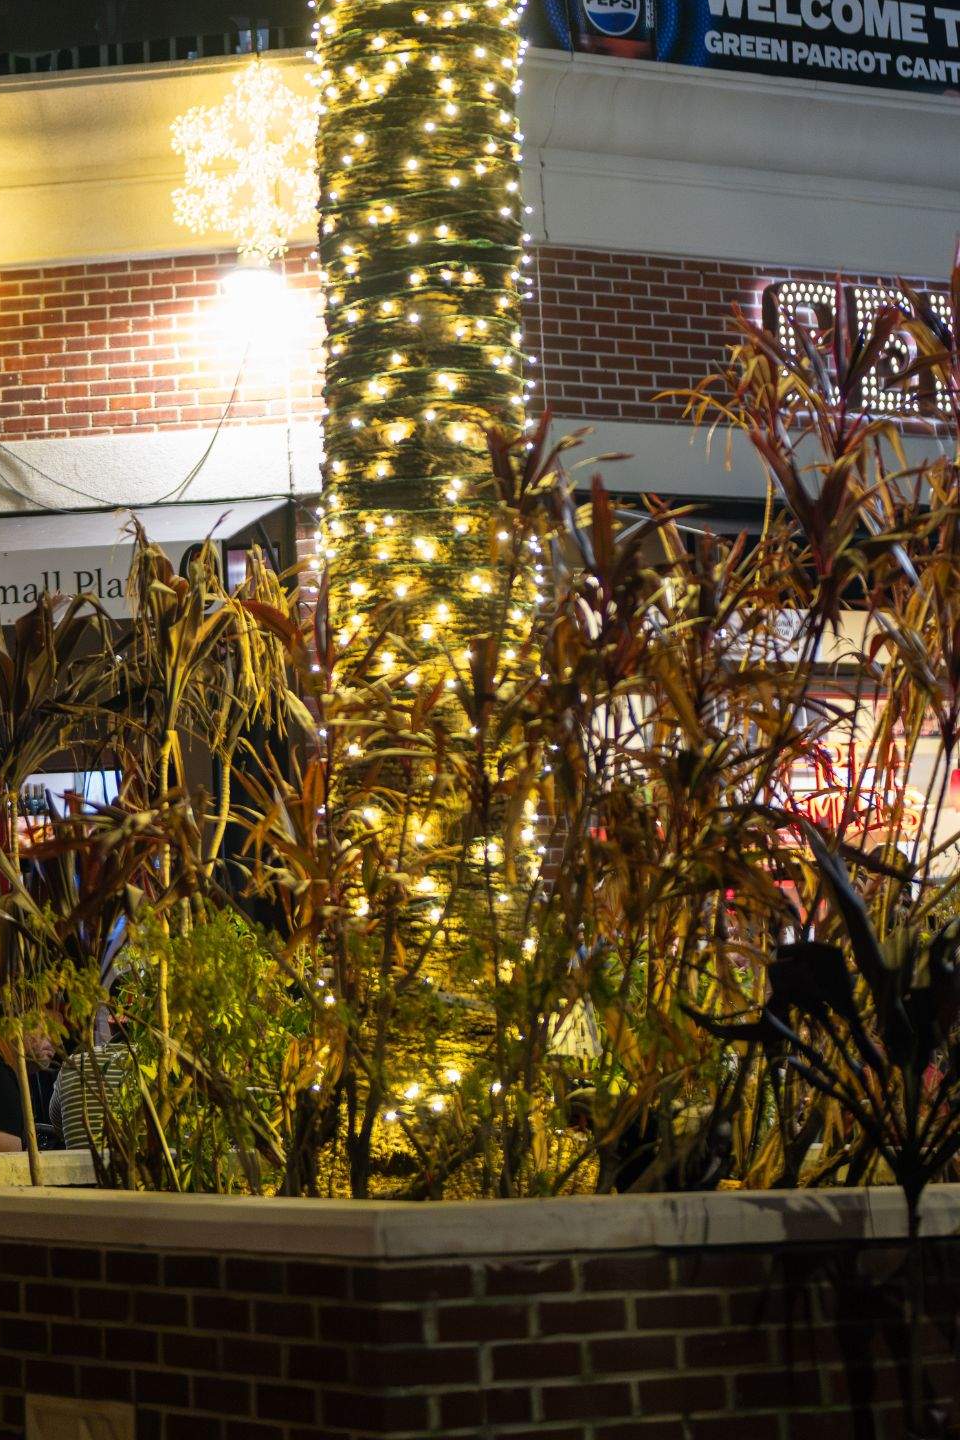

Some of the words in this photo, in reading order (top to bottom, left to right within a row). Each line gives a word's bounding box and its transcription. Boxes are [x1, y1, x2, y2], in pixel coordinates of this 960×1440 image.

[934, 6, 960, 48] T
[704, 30, 788, 62] GREEN
[792, 41, 891, 75] PARROT
[896, 54, 960, 84] CANT
[73, 567, 129, 600] Pla
